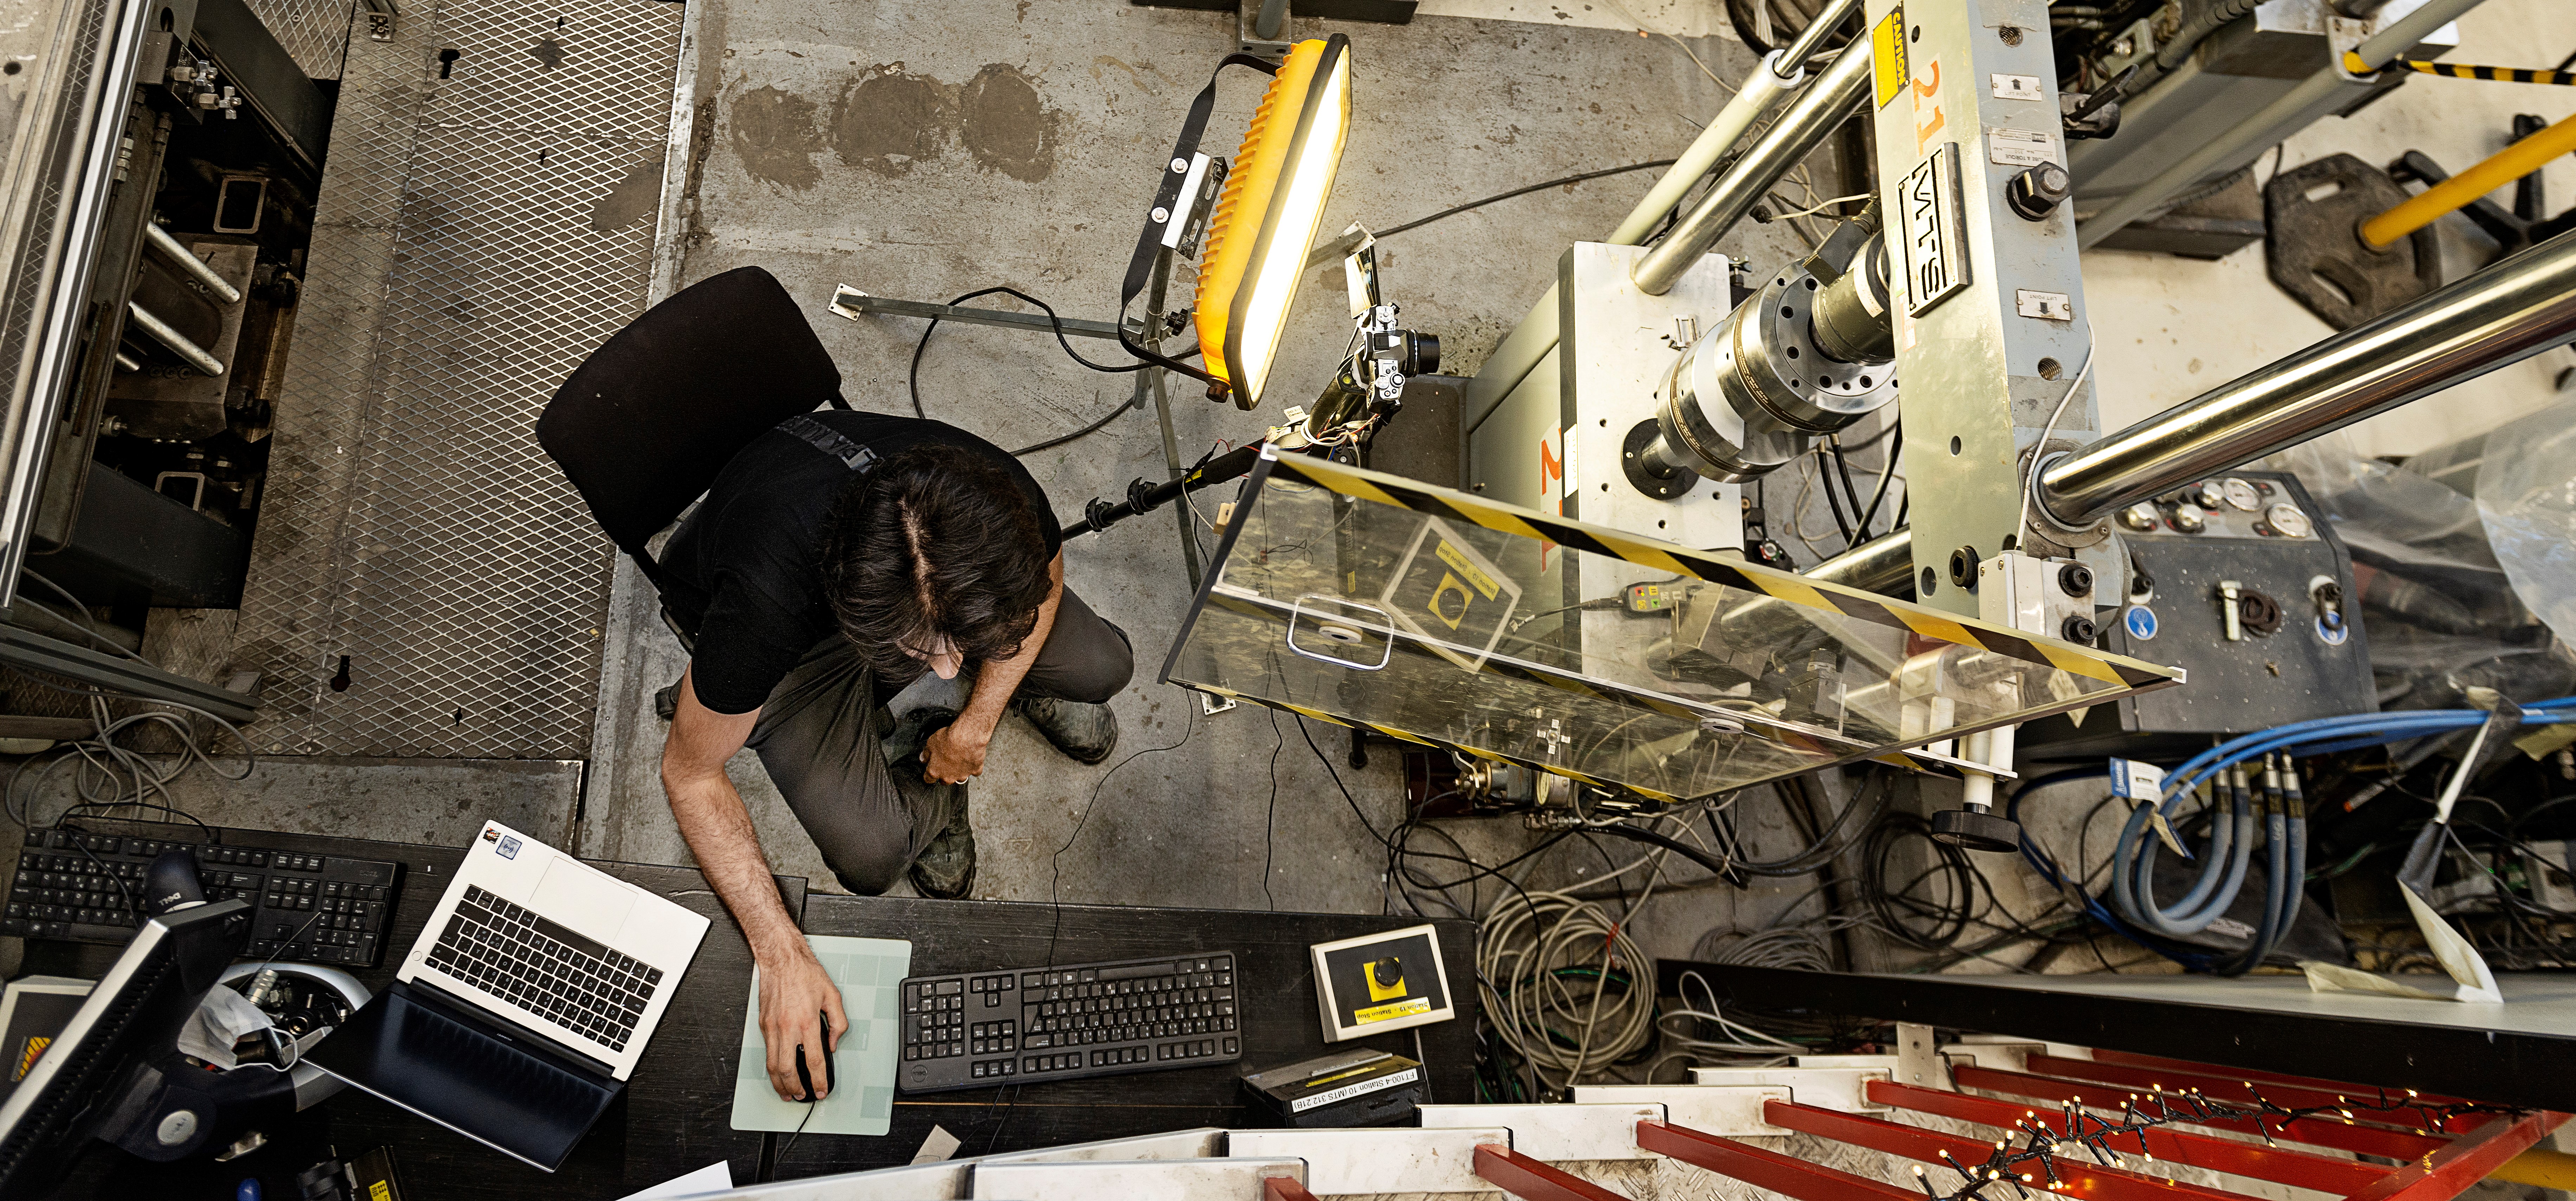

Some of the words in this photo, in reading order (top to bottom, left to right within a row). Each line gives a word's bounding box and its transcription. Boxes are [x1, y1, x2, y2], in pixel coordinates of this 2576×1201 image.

[1894, 12, 1906, 86] CAUTION
[1912, 60, 1944, 155] 21
[1912, 160, 1940, 301] MTS
[1359, 1080, 1383, 1090] Station
[1386, 1072, 1414, 1084] FT100-4
[1295, 1094, 1326, 1109] 312.21B)
[1328, 1089, 1346, 1099] (MTS
